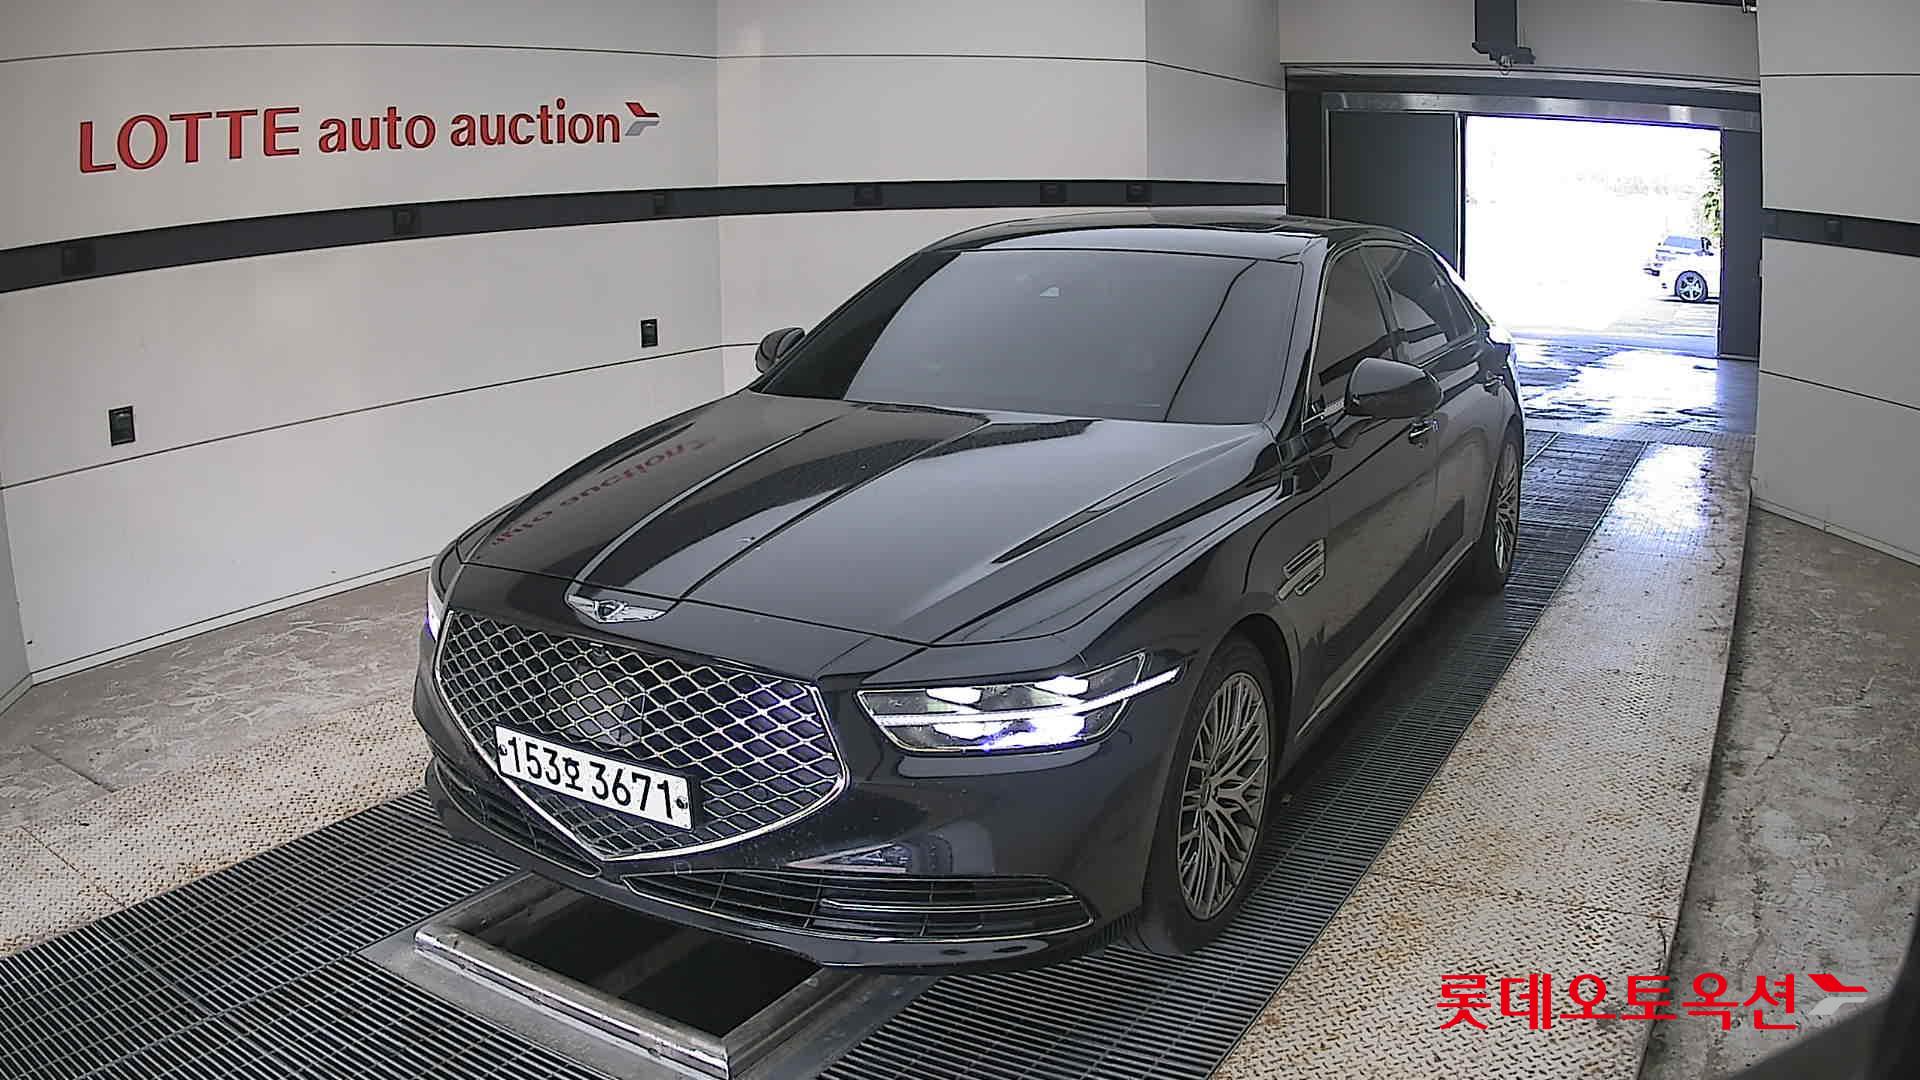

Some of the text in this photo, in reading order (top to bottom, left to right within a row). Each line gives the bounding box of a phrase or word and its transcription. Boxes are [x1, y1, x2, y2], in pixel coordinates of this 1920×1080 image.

[79, 98, 621, 173] LOTTE auto auction
